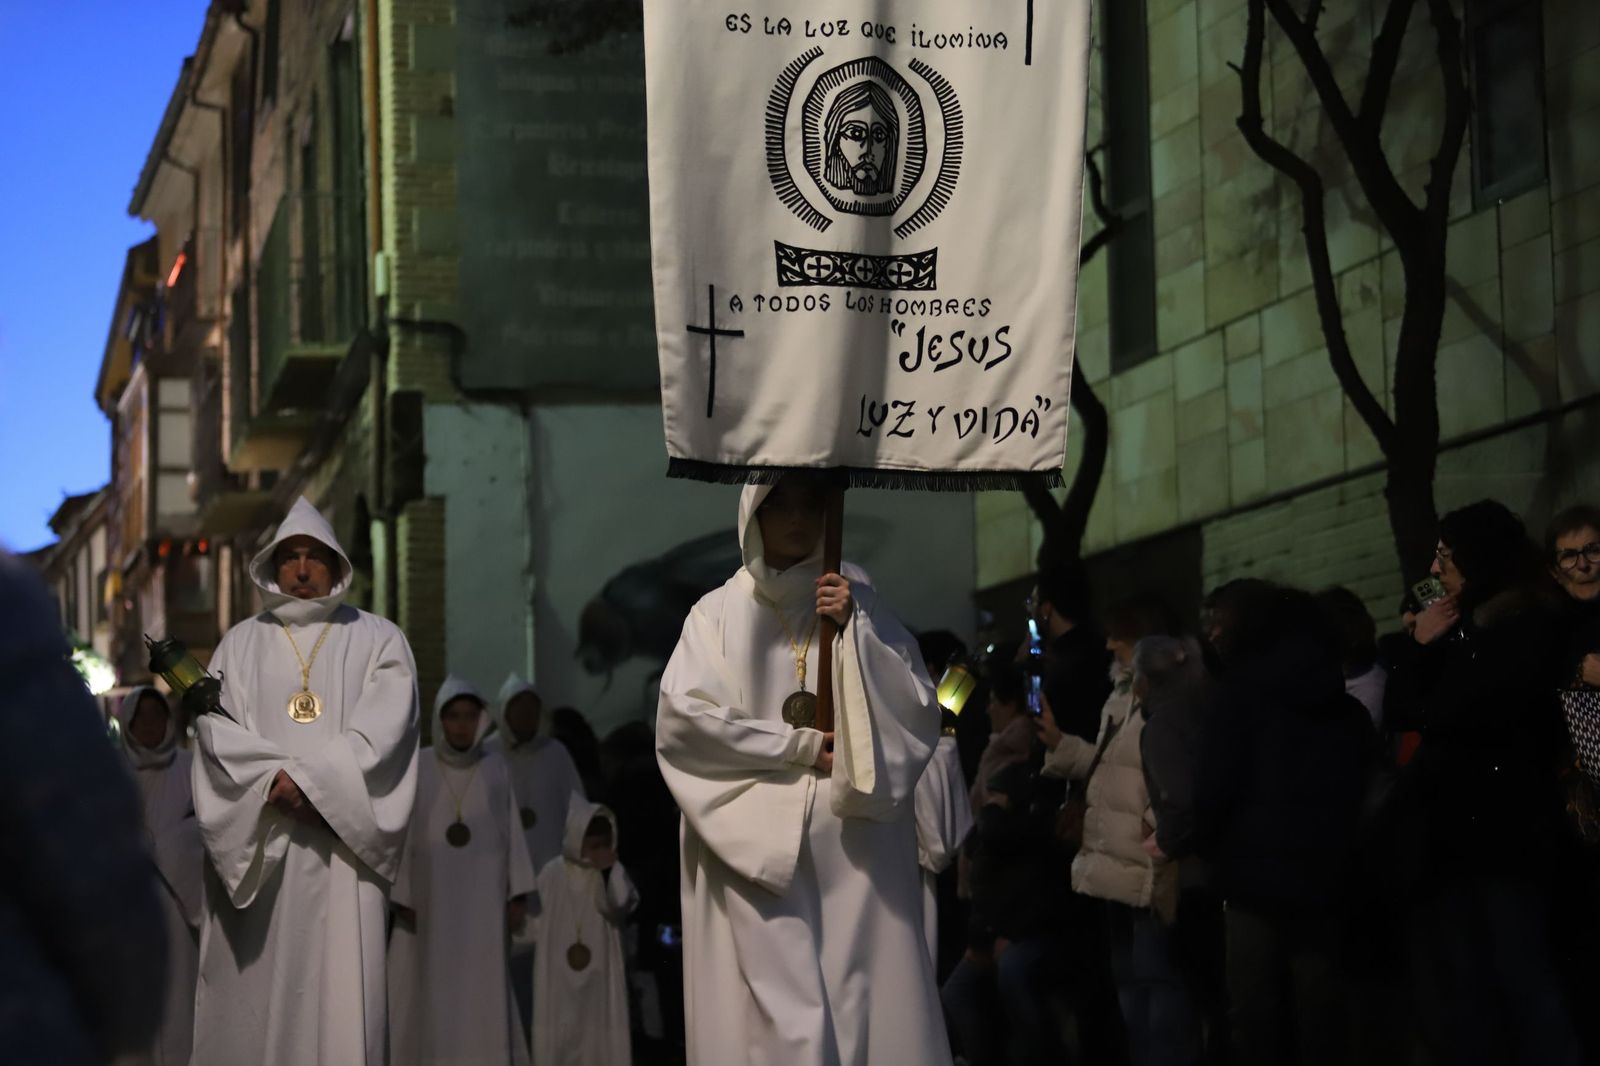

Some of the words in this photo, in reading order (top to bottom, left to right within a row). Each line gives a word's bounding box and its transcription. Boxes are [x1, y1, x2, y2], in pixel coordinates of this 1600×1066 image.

[725, 13, 753, 33] ES
[763, 17, 792, 36] LA
[805, 19, 850, 38] LUZ
[860, 21, 897, 45] QUE
[729, 294, 744, 313] A
[753, 293, 831, 313] TODOS
[845, 290, 875, 314] LOS
[879, 297, 992, 318] HOMBRES
[856, 393, 917, 439] LUZ
[927, 405, 946, 435] Y
